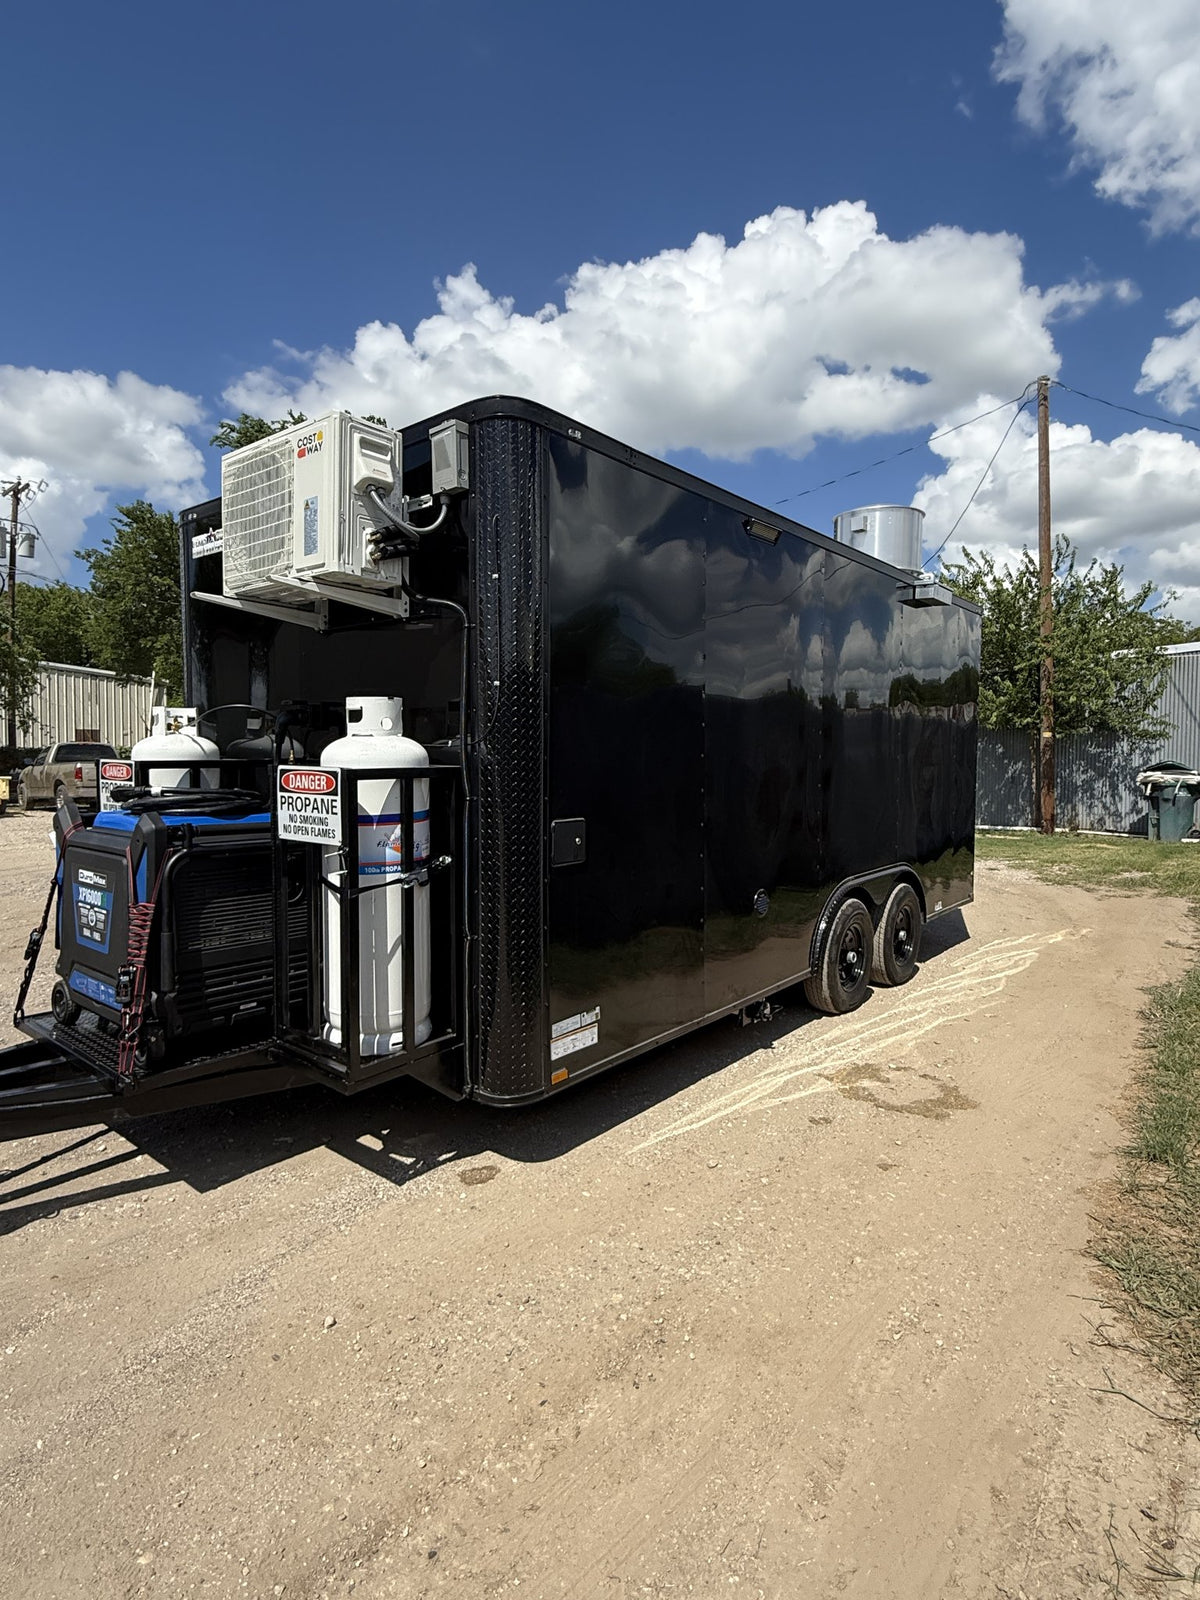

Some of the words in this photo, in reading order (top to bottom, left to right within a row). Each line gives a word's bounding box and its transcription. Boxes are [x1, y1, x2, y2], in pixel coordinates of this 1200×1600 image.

[297, 432, 317, 448] COST
[306, 441, 323, 455] WAY
[289, 774, 327, 790] DANGER
[280, 795, 338, 816] PROPANE
[289, 814, 298, 824] NO
[299, 814, 329, 827] SMOKING
[283, 824, 292, 834] NO
[293, 825, 309, 836] OPEN
[310, 826, 336, 839] FLAMES
[381, 865, 402, 873] PROPA
